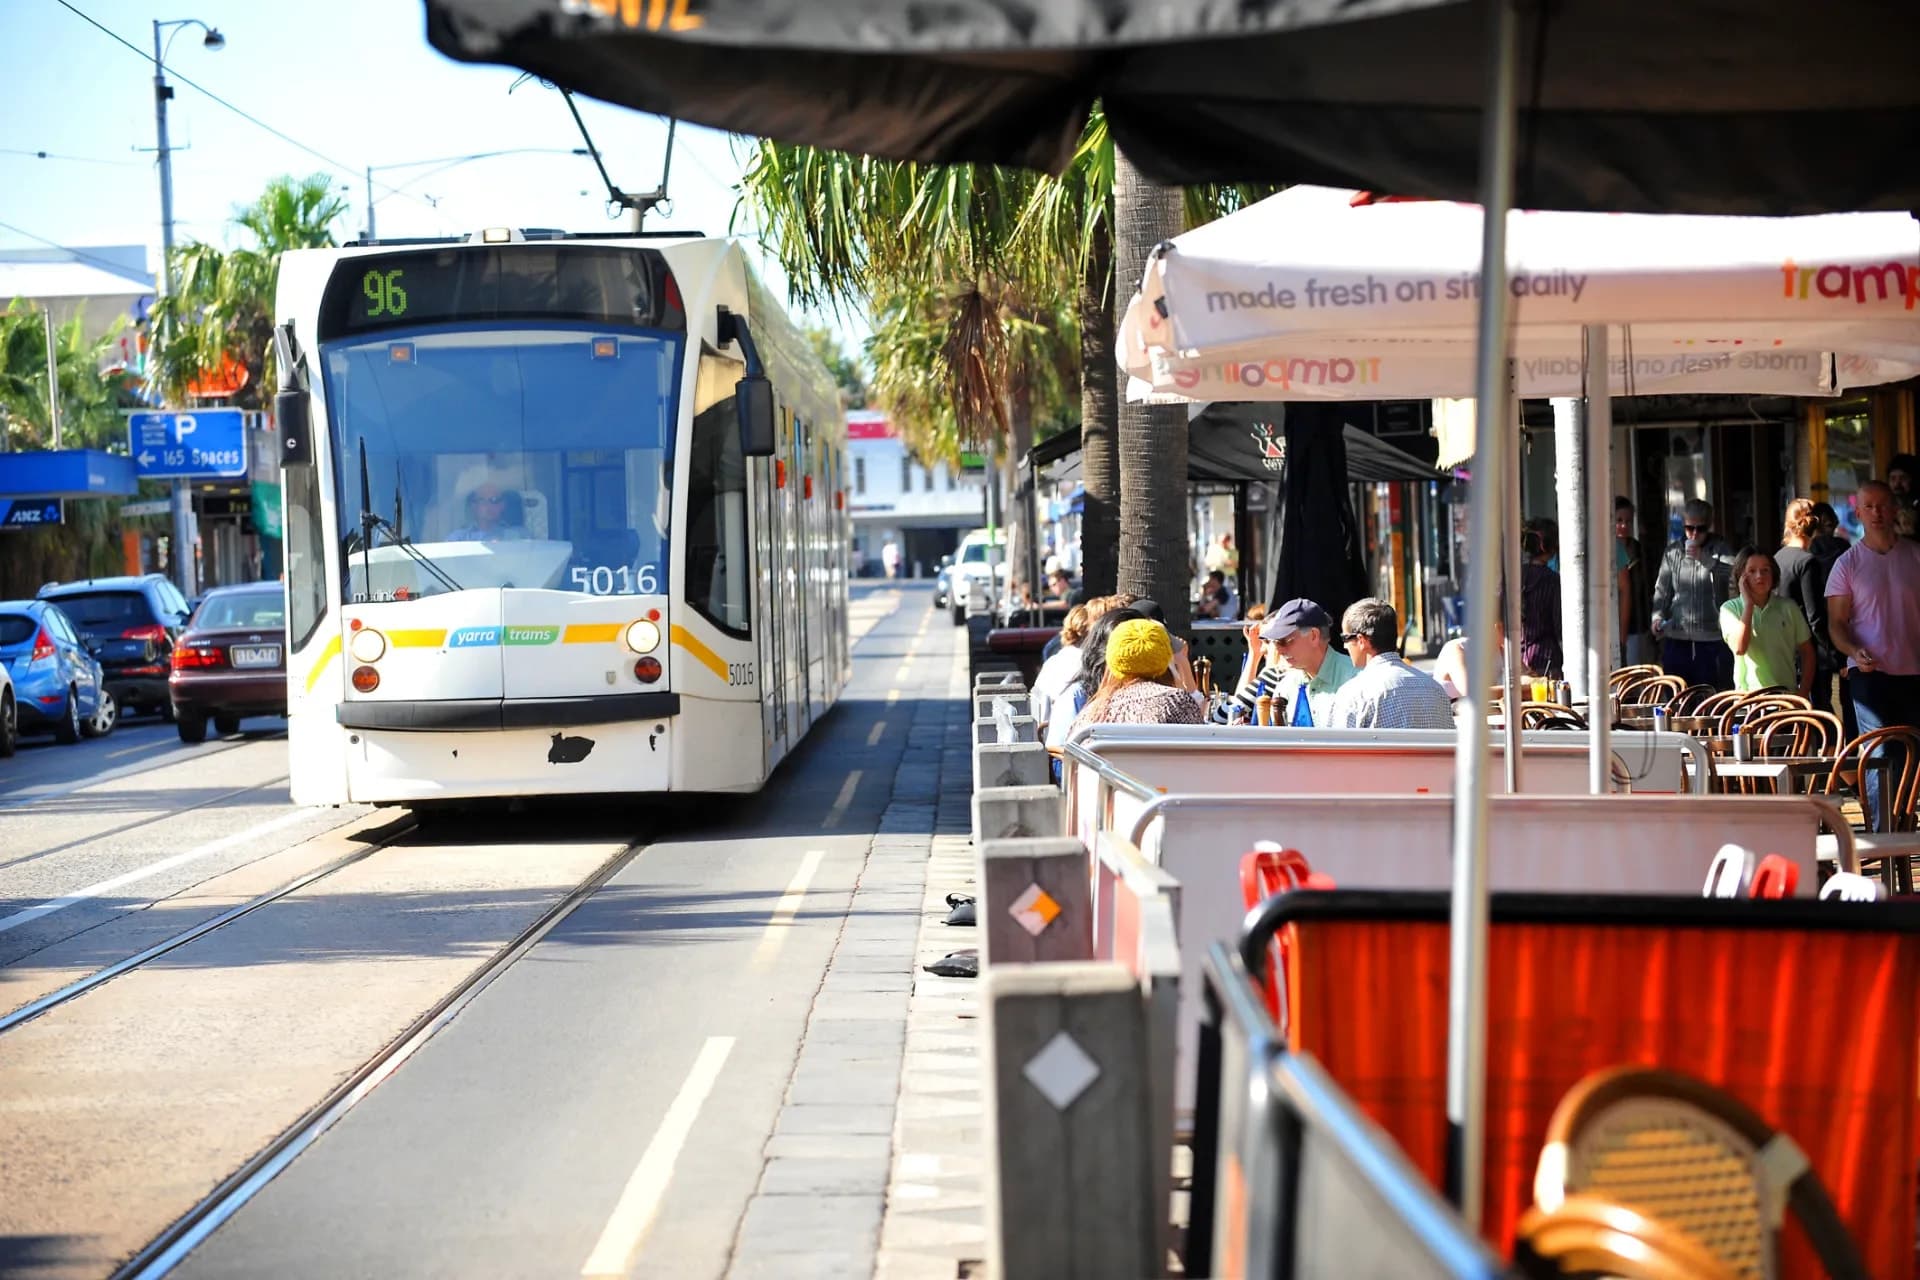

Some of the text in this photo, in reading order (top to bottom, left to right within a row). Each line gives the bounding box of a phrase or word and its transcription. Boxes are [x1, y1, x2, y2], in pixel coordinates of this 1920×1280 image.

[363, 269, 407, 316] 96
[1207, 267, 1587, 313] made fresh on sit daily
[175, 415, 196, 444] P
[163, 448, 239, 467] 165 Spaces
[11, 510, 41, 522] ANZ
[571, 565, 657, 595] 5016
[457, 627, 550, 646] yarra trams
[729, 662, 754, 686] 5016
